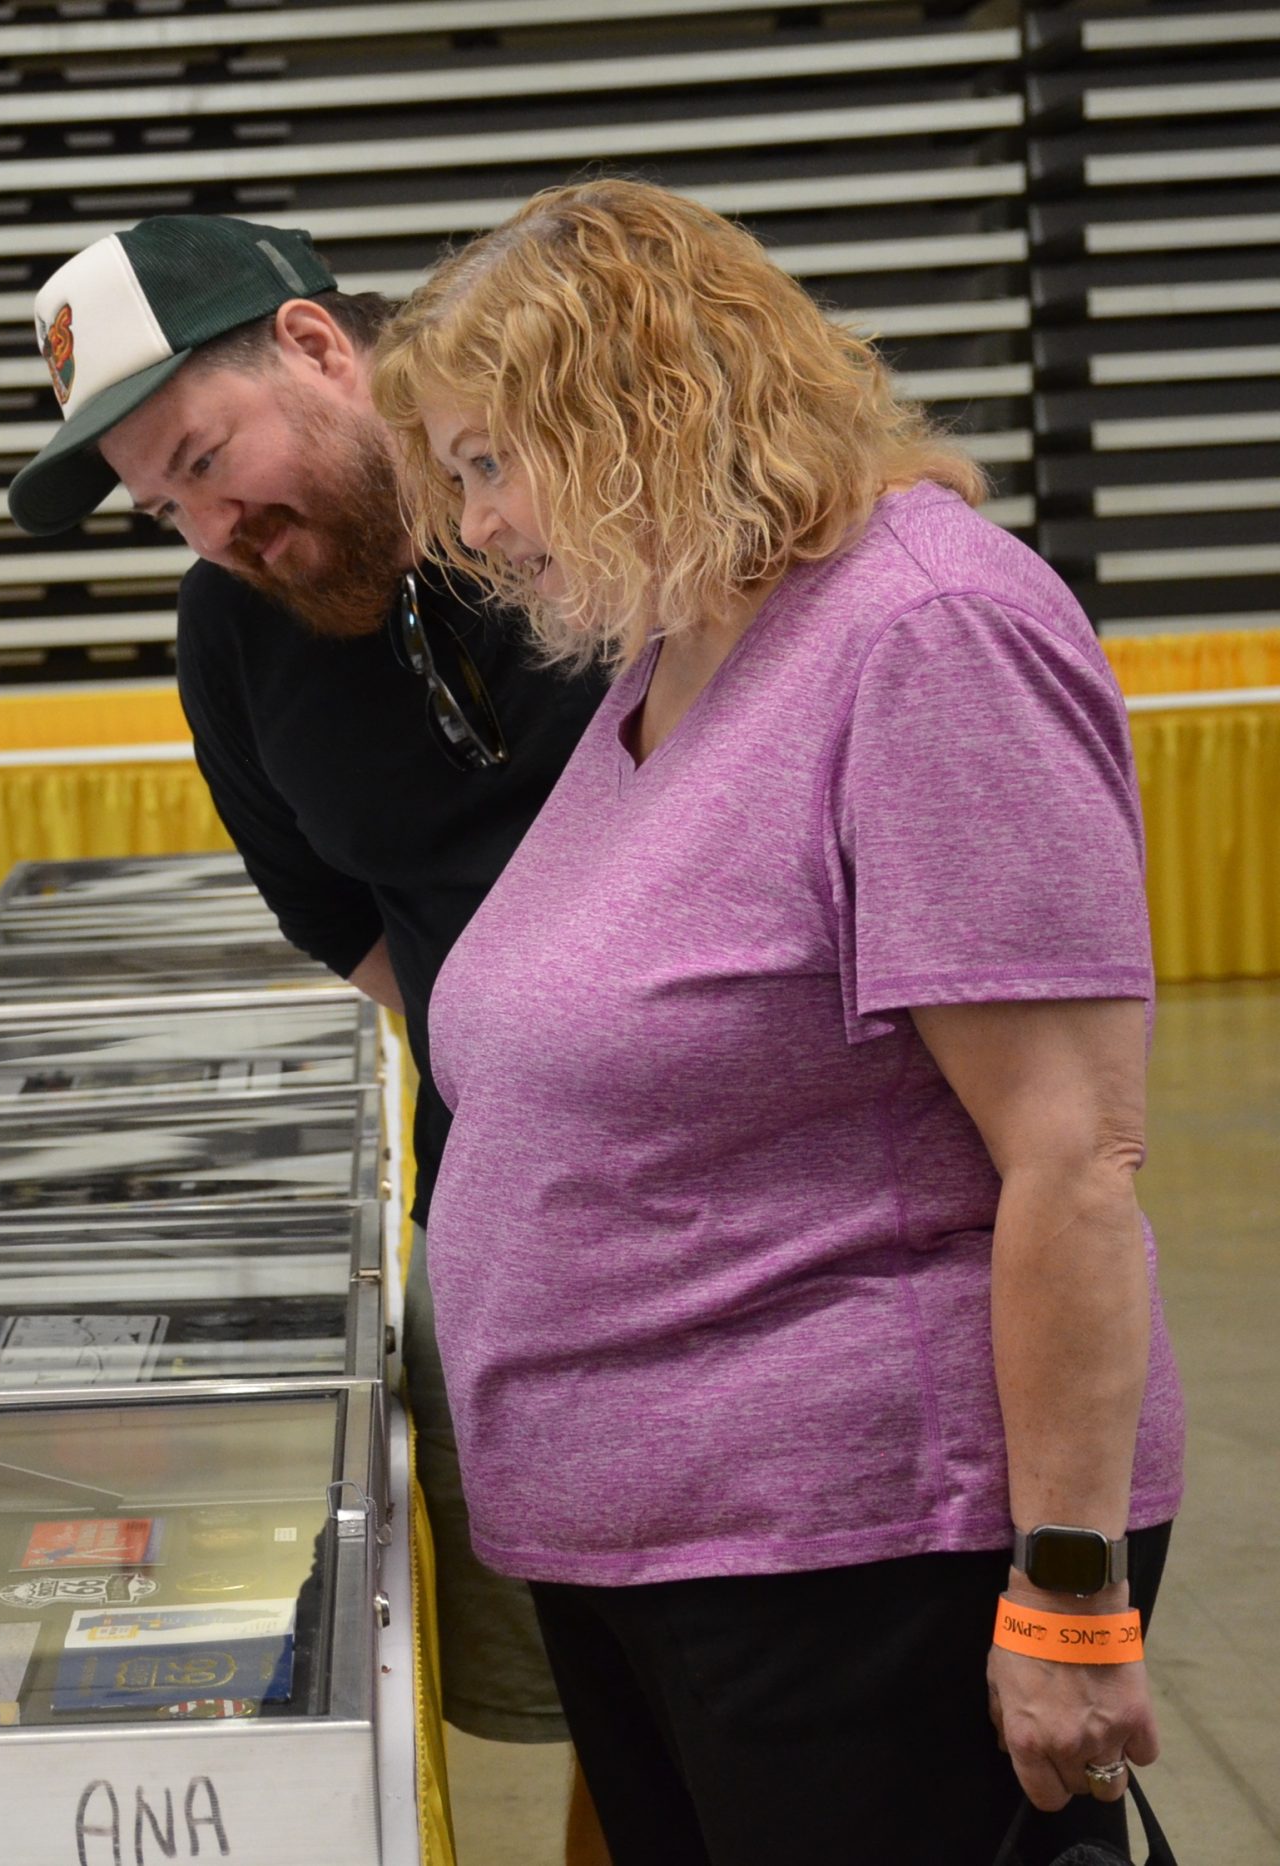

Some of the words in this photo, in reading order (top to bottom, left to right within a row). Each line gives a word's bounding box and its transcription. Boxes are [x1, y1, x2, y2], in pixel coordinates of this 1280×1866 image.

[61, 1579, 107, 1595] 66
[1003, 1615, 1032, 1638] PMG
[1059, 1628, 1095, 1644] NCS
[165, 1659, 218, 1685] 66
[75, 1775, 231, 1866] ANA
